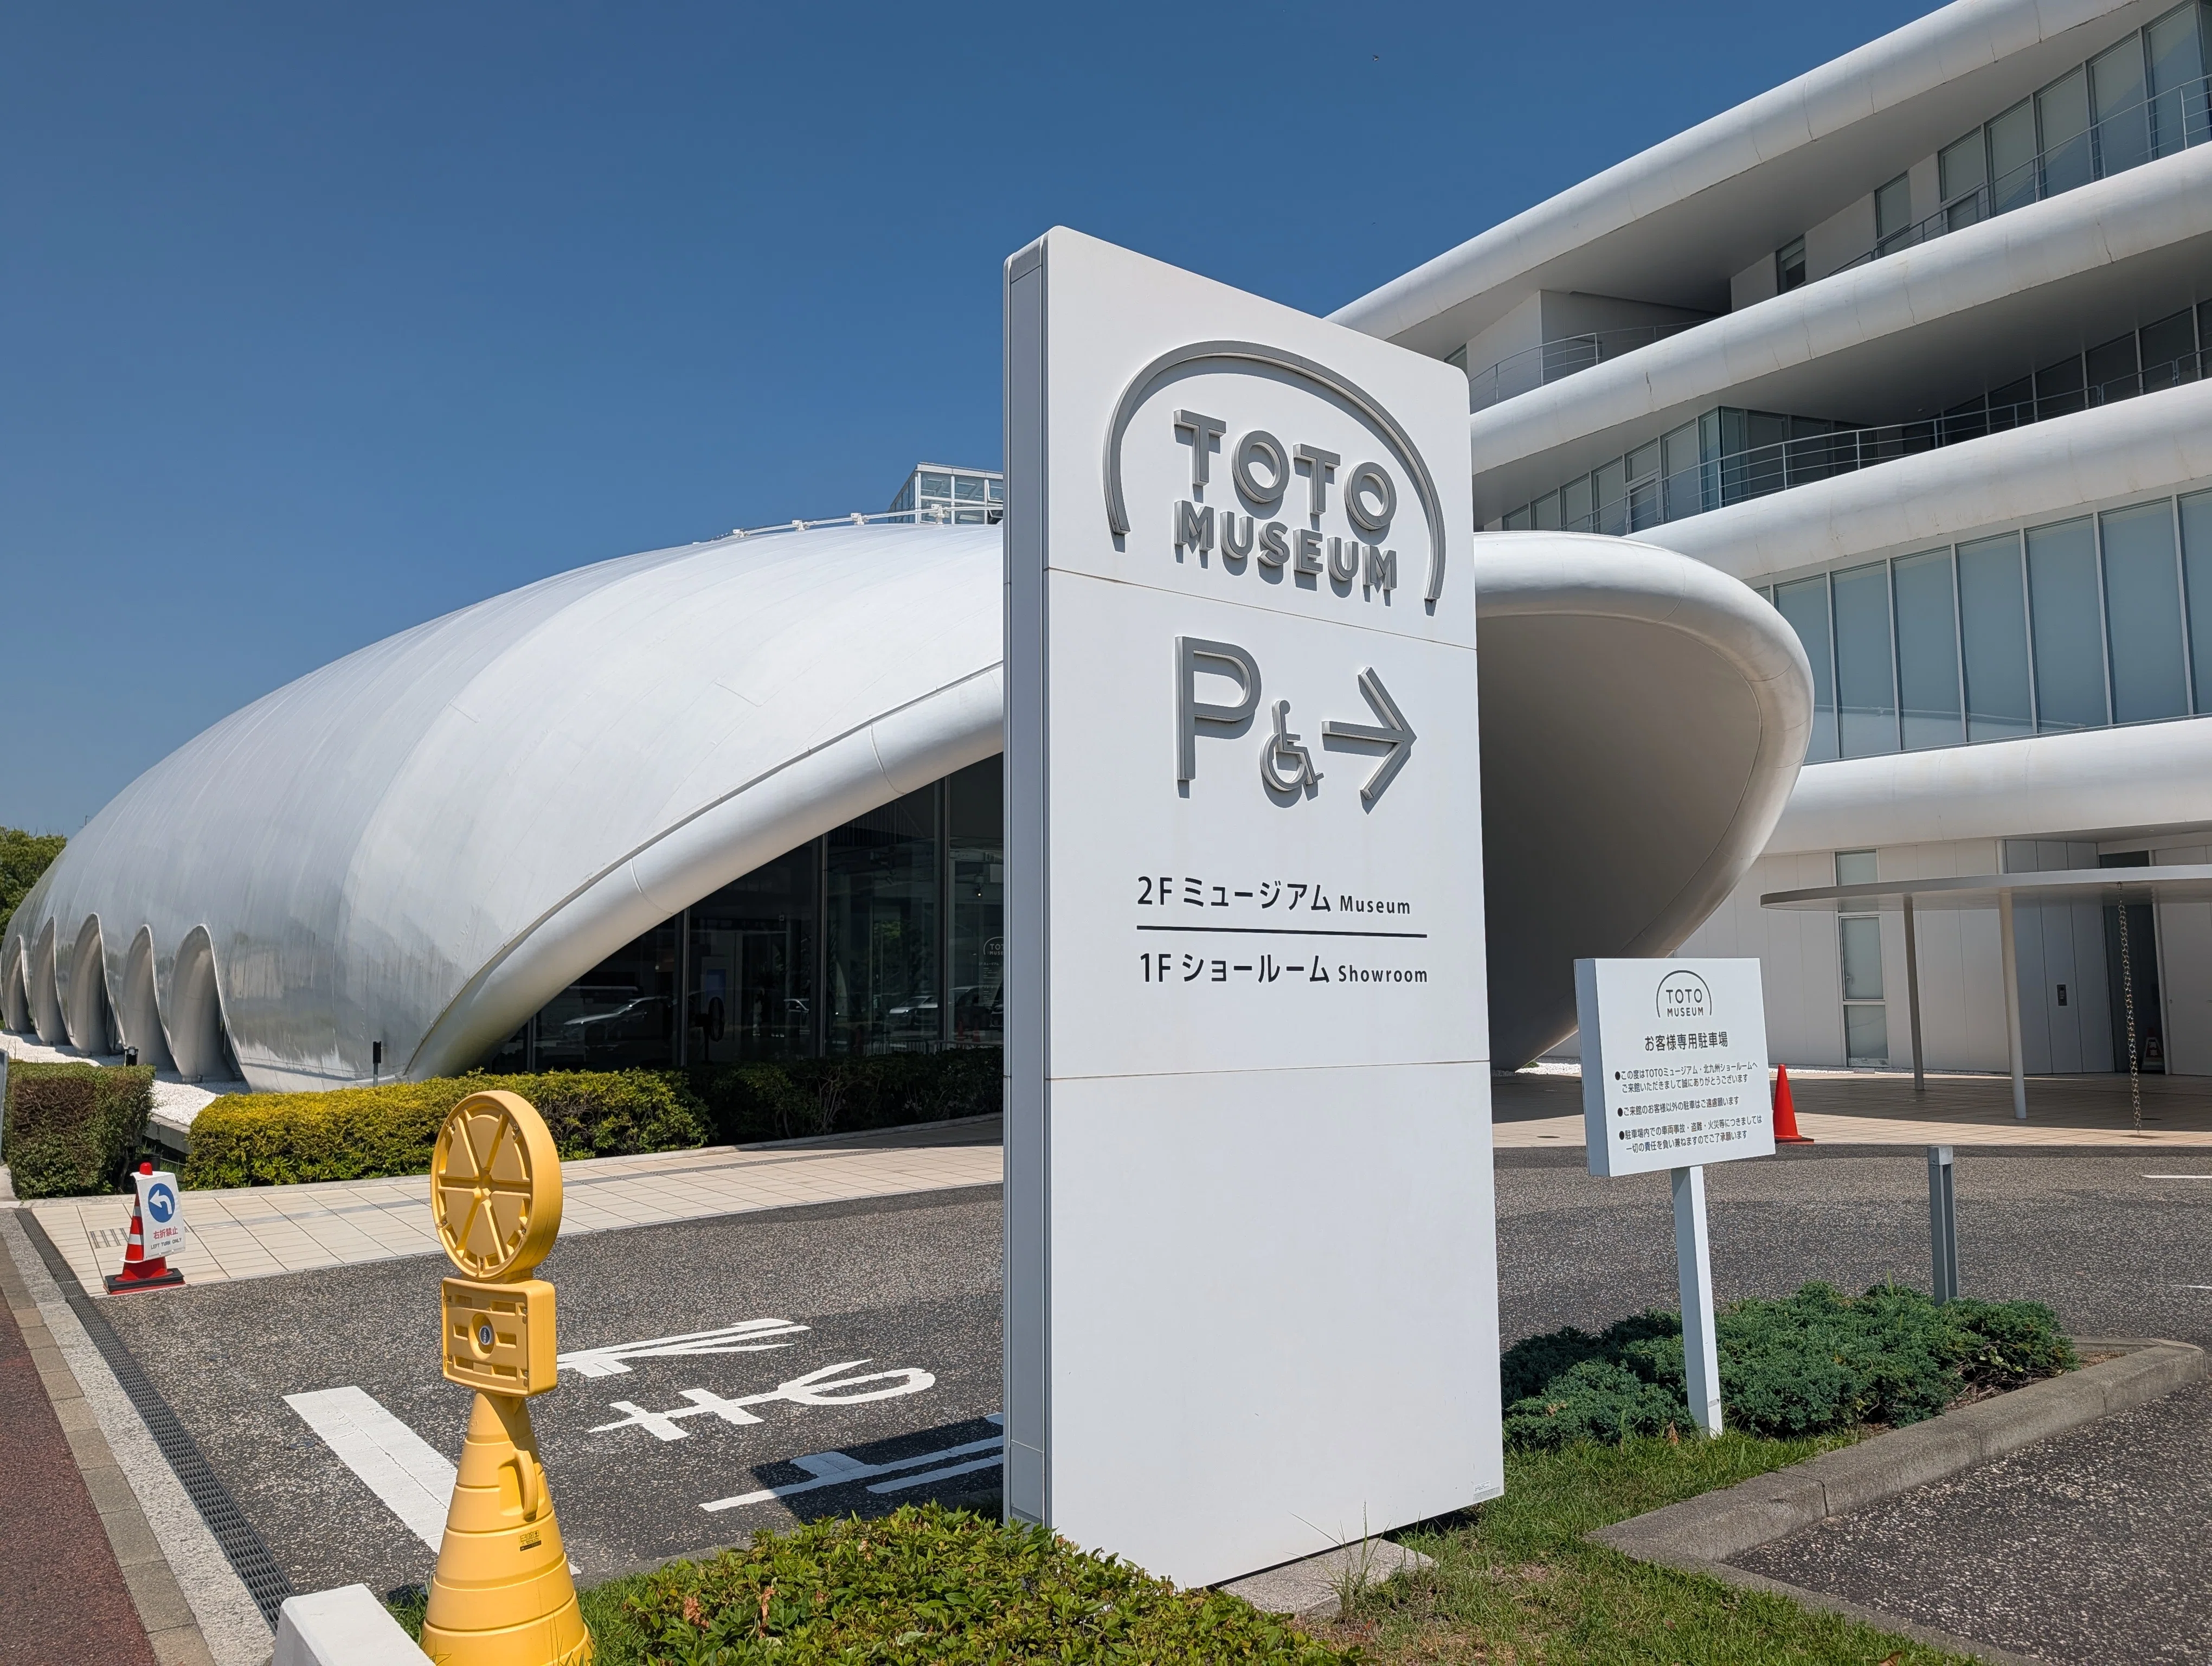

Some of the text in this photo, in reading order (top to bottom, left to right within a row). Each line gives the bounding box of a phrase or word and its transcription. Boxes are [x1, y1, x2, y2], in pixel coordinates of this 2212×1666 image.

[1174, 409, 1397, 531] TOTO
[1174, 499, 1397, 591] MUSEUM
[1175, 636, 1262, 781] P
[1340, 895, 1411, 914] Museum
[1338, 964, 1428, 983] Showroom
[1666, 988, 1702, 1004] TOTO
[1667, 1007, 1704, 1017] MUSEUM
[1644, 1031, 1728, 1052] お客様専用駐車場
[1622, 1074, 1748, 1093] ご来館いただきまして誠にありがとうございます
[1623, 1096, 1739, 1117] ご来館のお客様以外の駐車はご遠慮願います
[1626, 1130, 1747, 1153] 一切の責任を負い兼ねますのでご了承願います
[153, 1226, 178, 1239] 右折禁止
